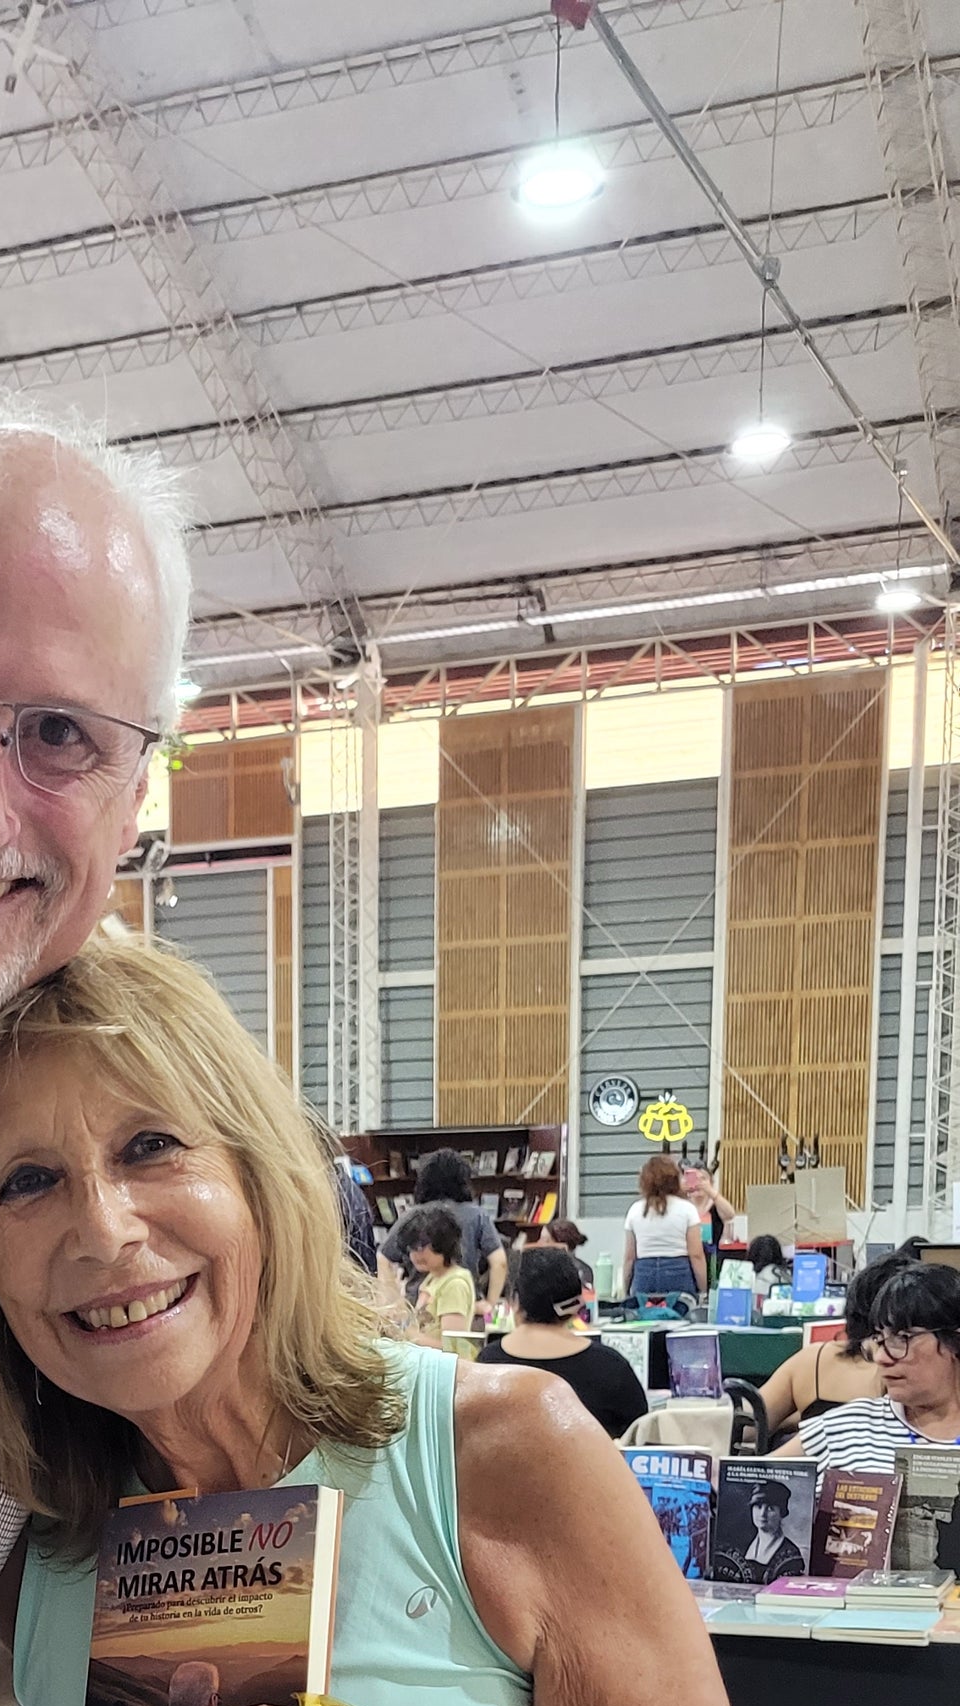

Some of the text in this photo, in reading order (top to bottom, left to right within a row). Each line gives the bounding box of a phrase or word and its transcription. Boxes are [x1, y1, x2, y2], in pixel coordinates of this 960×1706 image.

[631, 1455, 708, 1479] CHILE
[116, 1521, 293, 1566] IMPOSIBLE NO
[117, 1556, 283, 1599] MIRAR ATRÁS
[166, 1600, 185, 1610] para
[186, 1595, 226, 1606] descubrir
[228, 1594, 236, 1603] el
[238, 1592, 273, 1604] impacto
[129, 1613, 139, 1623] de
[140, 1614, 149, 1622] tu
[150, 1611, 181, 1621] historia
[194, 1608, 202, 1617] la
[203, 1606, 221, 1616] vida
[223, 1606, 234, 1615] de
[235, 1604, 264, 1614] otros?
